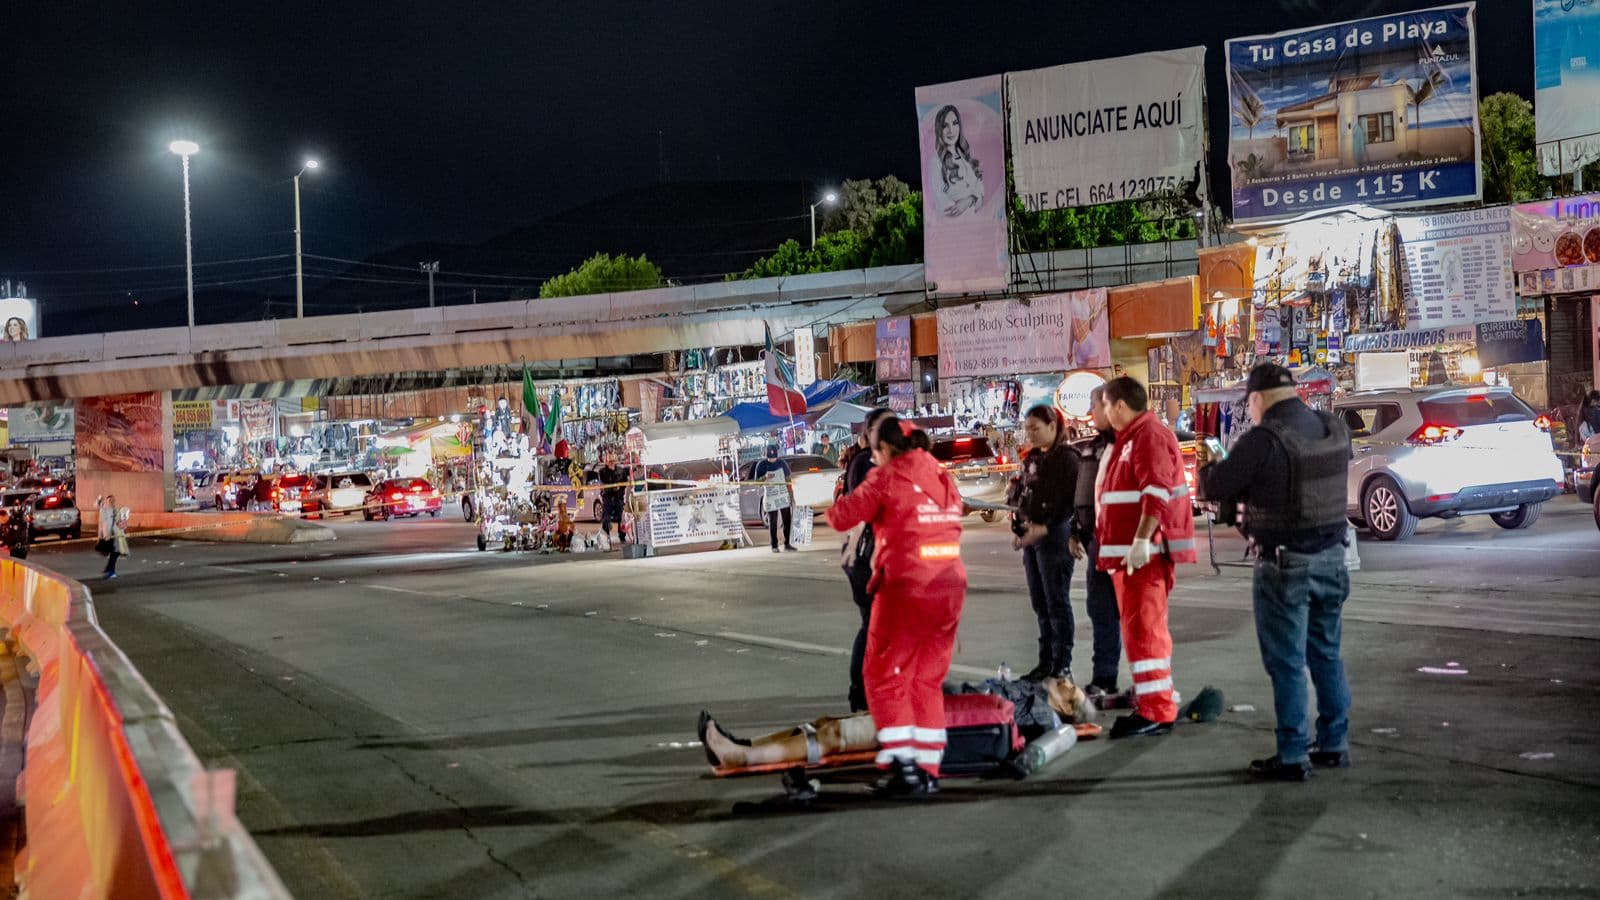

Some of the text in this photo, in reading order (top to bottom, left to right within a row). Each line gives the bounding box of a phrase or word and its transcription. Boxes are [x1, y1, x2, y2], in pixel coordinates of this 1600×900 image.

[1249, 18, 1448, 62] Tu Casa de Playa
[1024, 92, 1182, 145] ANUNCIATE AQUÍ
[1089, 182, 1115, 203] 664
[1262, 182, 1342, 207] Desde
[1355, 174, 1404, 197] 115
[1432, 212, 1472, 226] BIONICOS
[1473, 211, 1484, 220] EL
[1486, 208, 1510, 219] NETO
[942, 311, 1064, 336] Sacred Body Sculpting
[1391, 328, 1446, 348] BIONICOS
